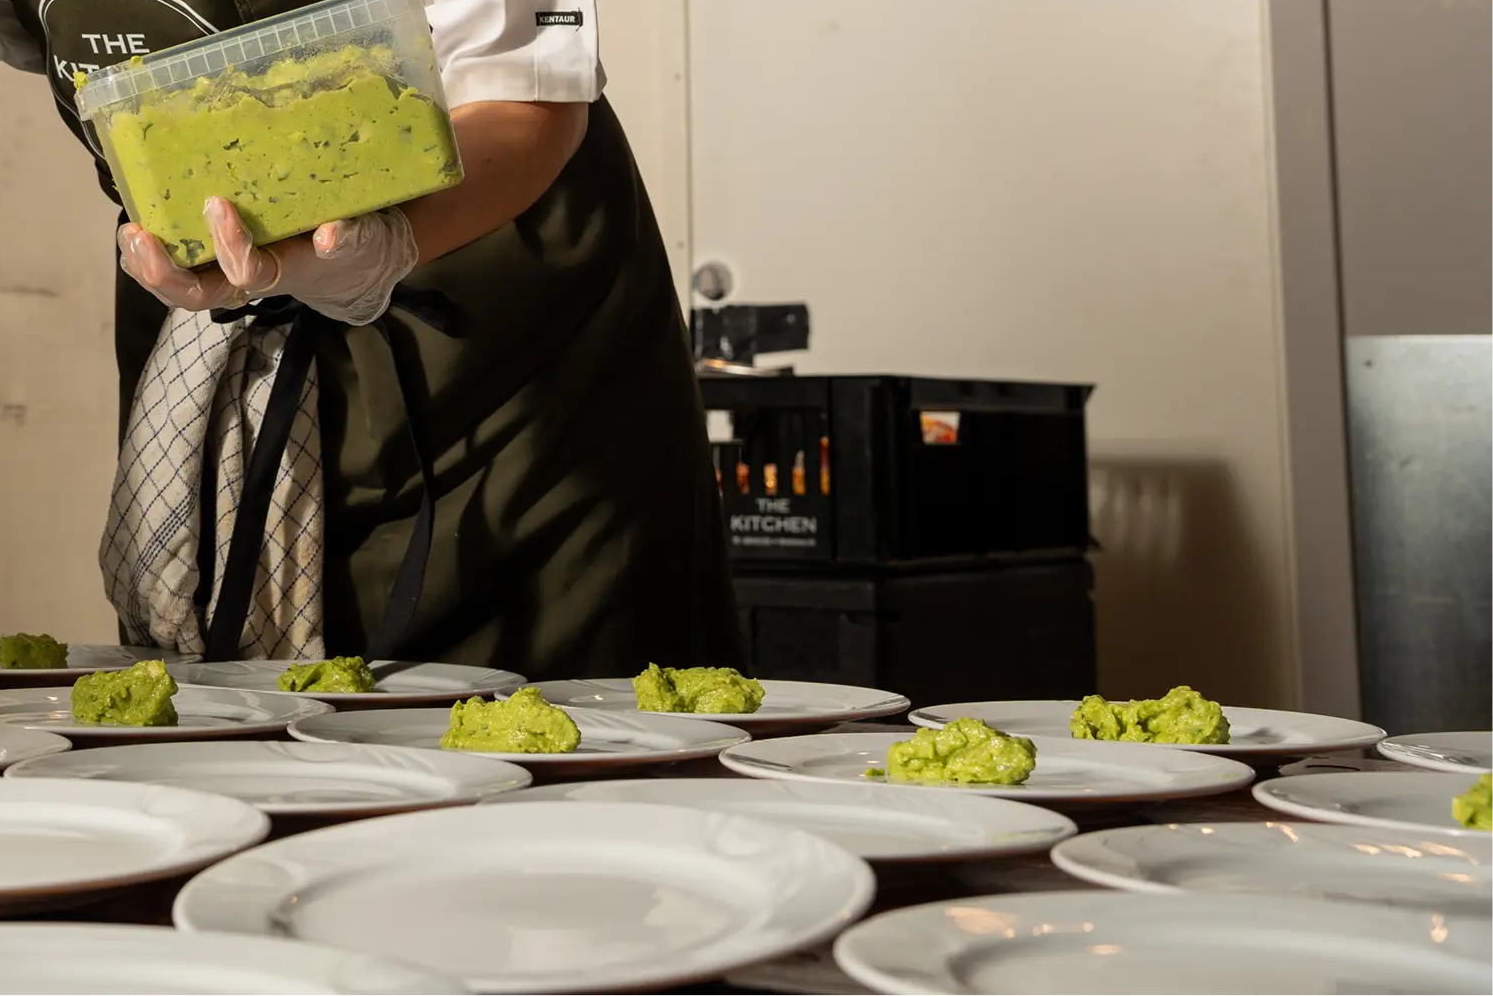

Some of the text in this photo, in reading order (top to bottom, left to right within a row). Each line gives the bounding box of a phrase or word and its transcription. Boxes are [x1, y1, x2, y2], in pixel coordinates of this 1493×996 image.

[539, 15, 576, 24] KENTAUR
[81, 33, 150, 55] THE
[755, 498, 791, 514] THE
[730, 515, 817, 534] KITCHEN
